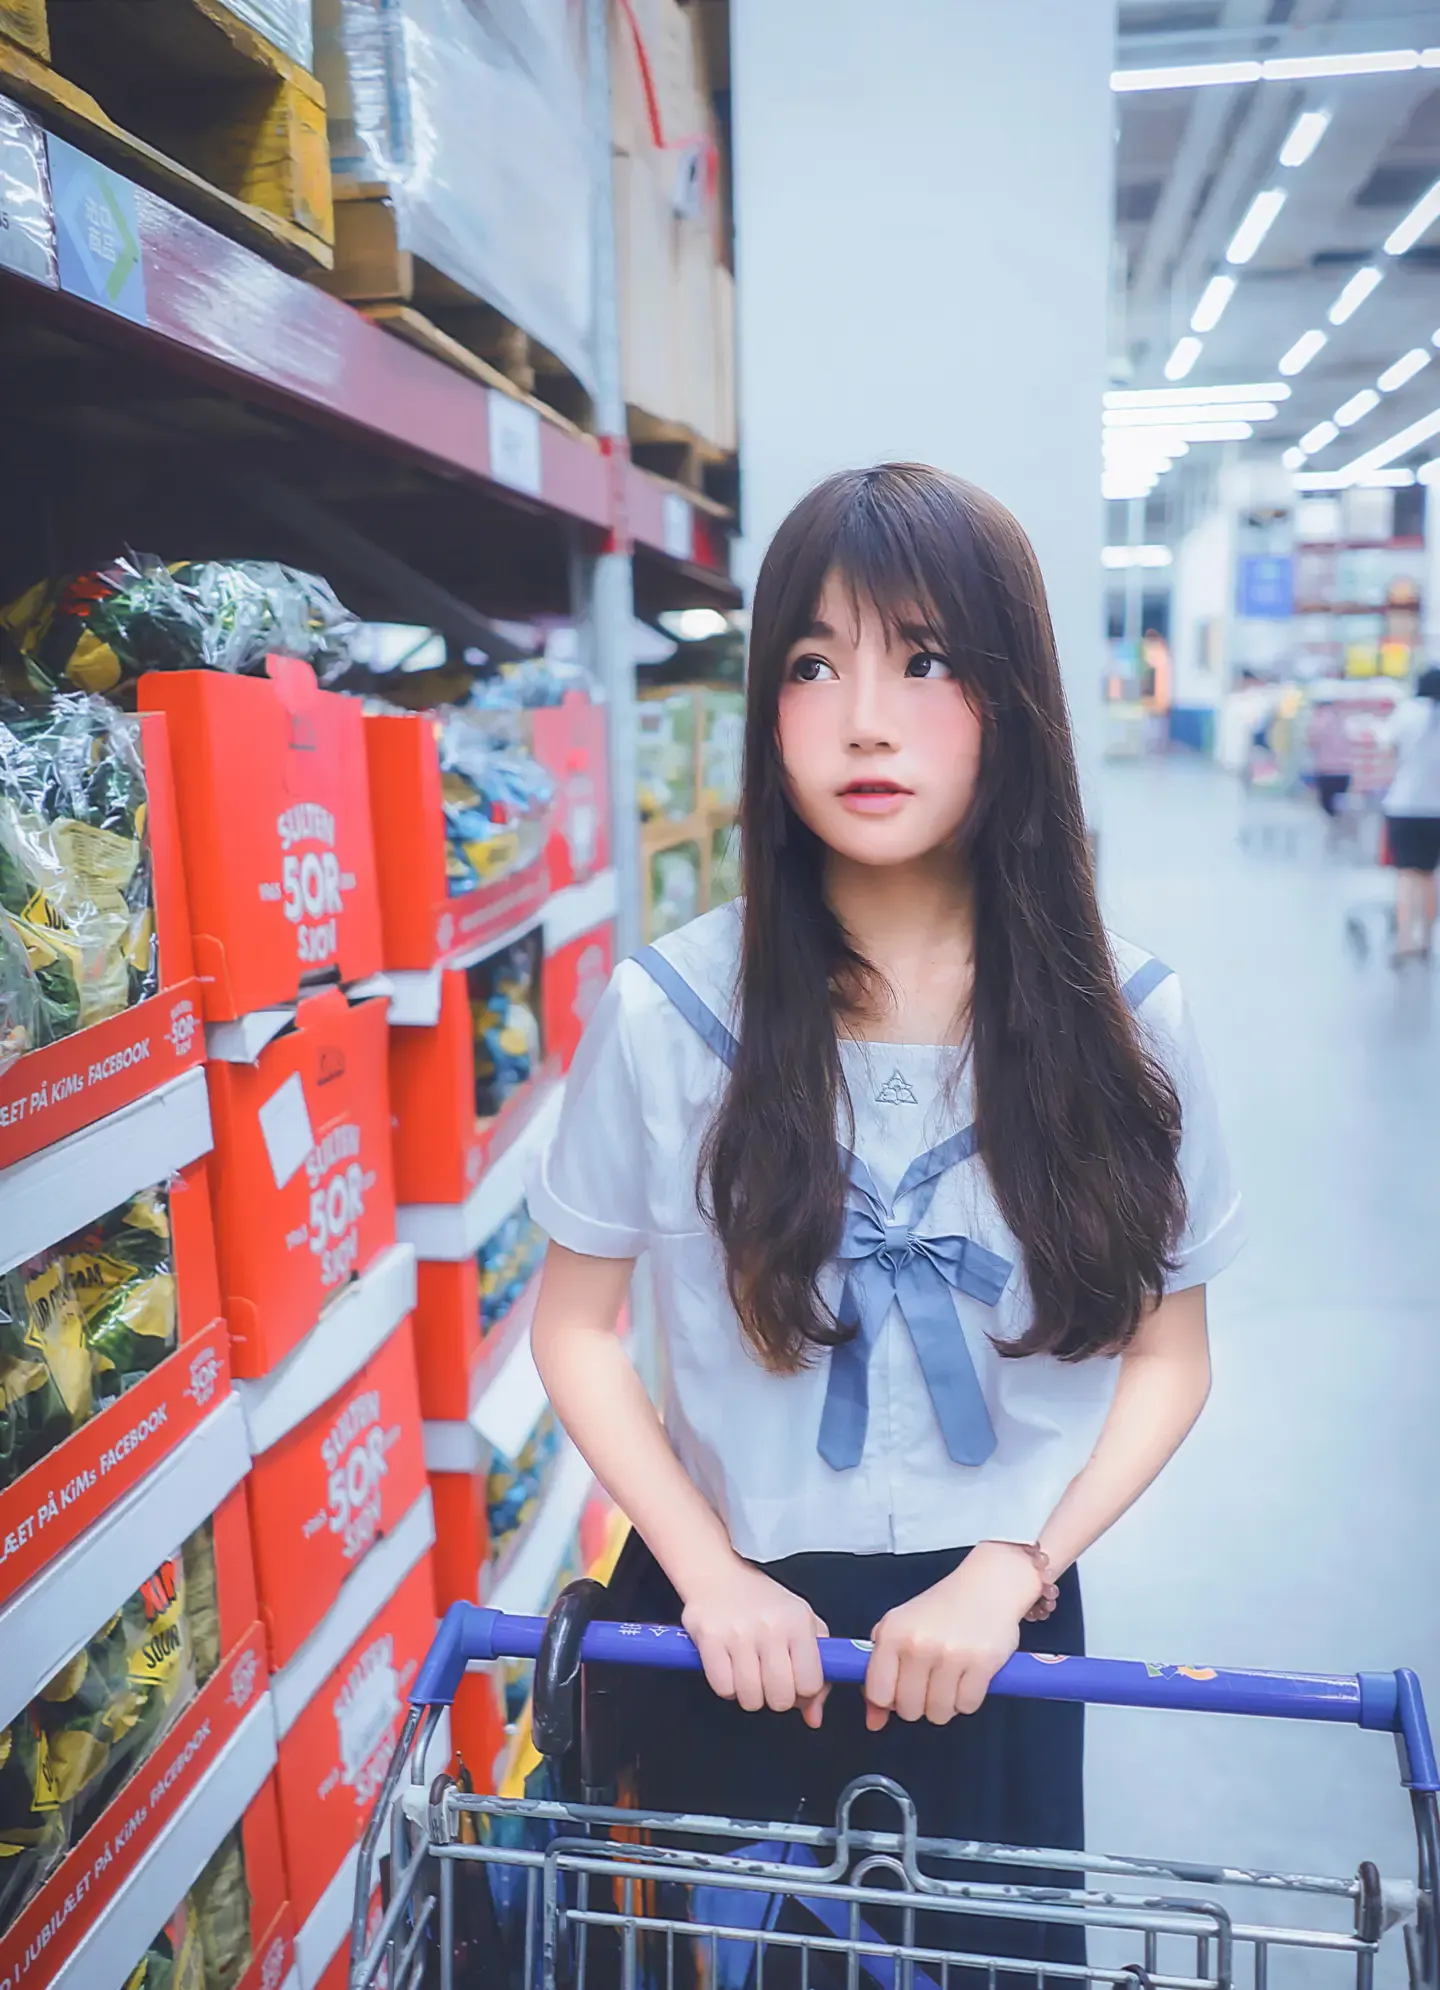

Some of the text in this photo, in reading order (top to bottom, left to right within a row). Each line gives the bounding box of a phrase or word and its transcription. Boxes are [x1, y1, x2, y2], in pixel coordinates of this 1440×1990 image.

[29, 1081, 48, 1114] PÅ
[87, 1038, 151, 1087] FACEBOOK
[37, 1491, 59, 1529] PÅ
[99, 1402, 169, 1476] FACEBOOK
[23, 1871, 91, 1973] JUBILÆET
[94, 1842, 113, 1879] PÅ
[150, 1717, 212, 1808] FACEBOOK
